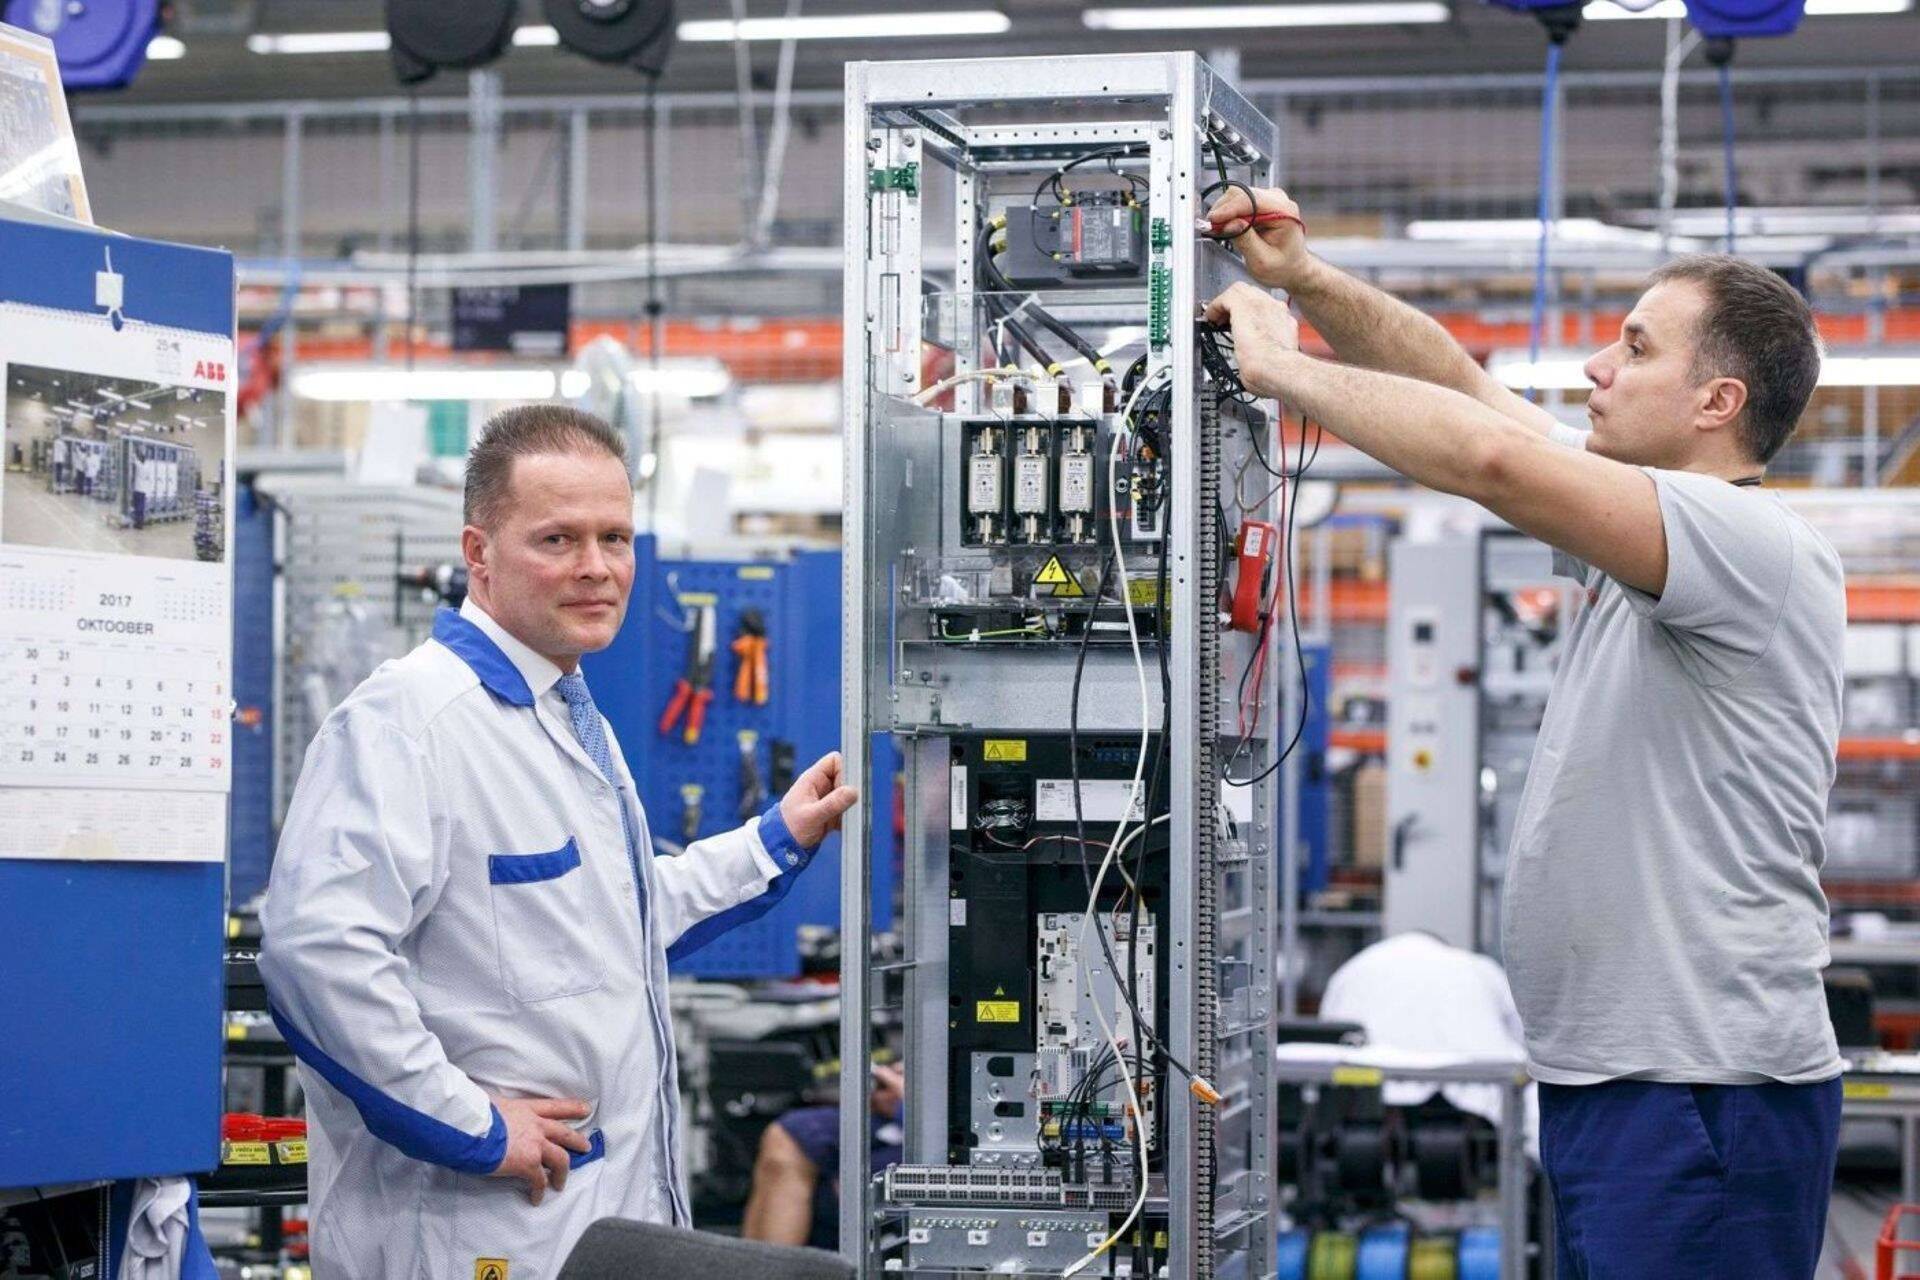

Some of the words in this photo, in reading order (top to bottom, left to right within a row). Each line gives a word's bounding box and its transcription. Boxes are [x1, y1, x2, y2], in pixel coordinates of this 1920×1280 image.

[195, 360, 226, 381] ABB
[100, 594, 131, 606] 2017
[78, 618, 153, 634] OKTOOBER
[31, 674, 38, 685] 2
[63, 676, 70, 687] 3
[95, 678, 102, 688] 4
[126, 680, 133, 690] 5
[156, 681, 163, 692] 6
[187, 682, 194, 693] 7
[29, 699, 36, 710] 9
[58, 702, 69, 712] 10
[89, 703, 101, 714] 11
[120, 704, 132, 715] 12
[152, 706, 163, 716] 13
[181, 707, 193, 718] 14
[24, 726, 35, 736] 16
[56, 727, 68, 737] 17
[89, 728, 100, 739] 18
[120, 729, 132, 740] 19
[151, 731, 162, 741] 20
[180, 732, 192, 743] 21
[210, 733, 222, 744] 22
[22, 751, 33, 761] 23
[54, 752, 66, 762] 24
[86, 753, 98, 764] 25
[118, 755, 130, 765] 26
[149, 756, 161, 766] 27
[180, 757, 192, 768] 28
[210, 758, 222, 768] 29
